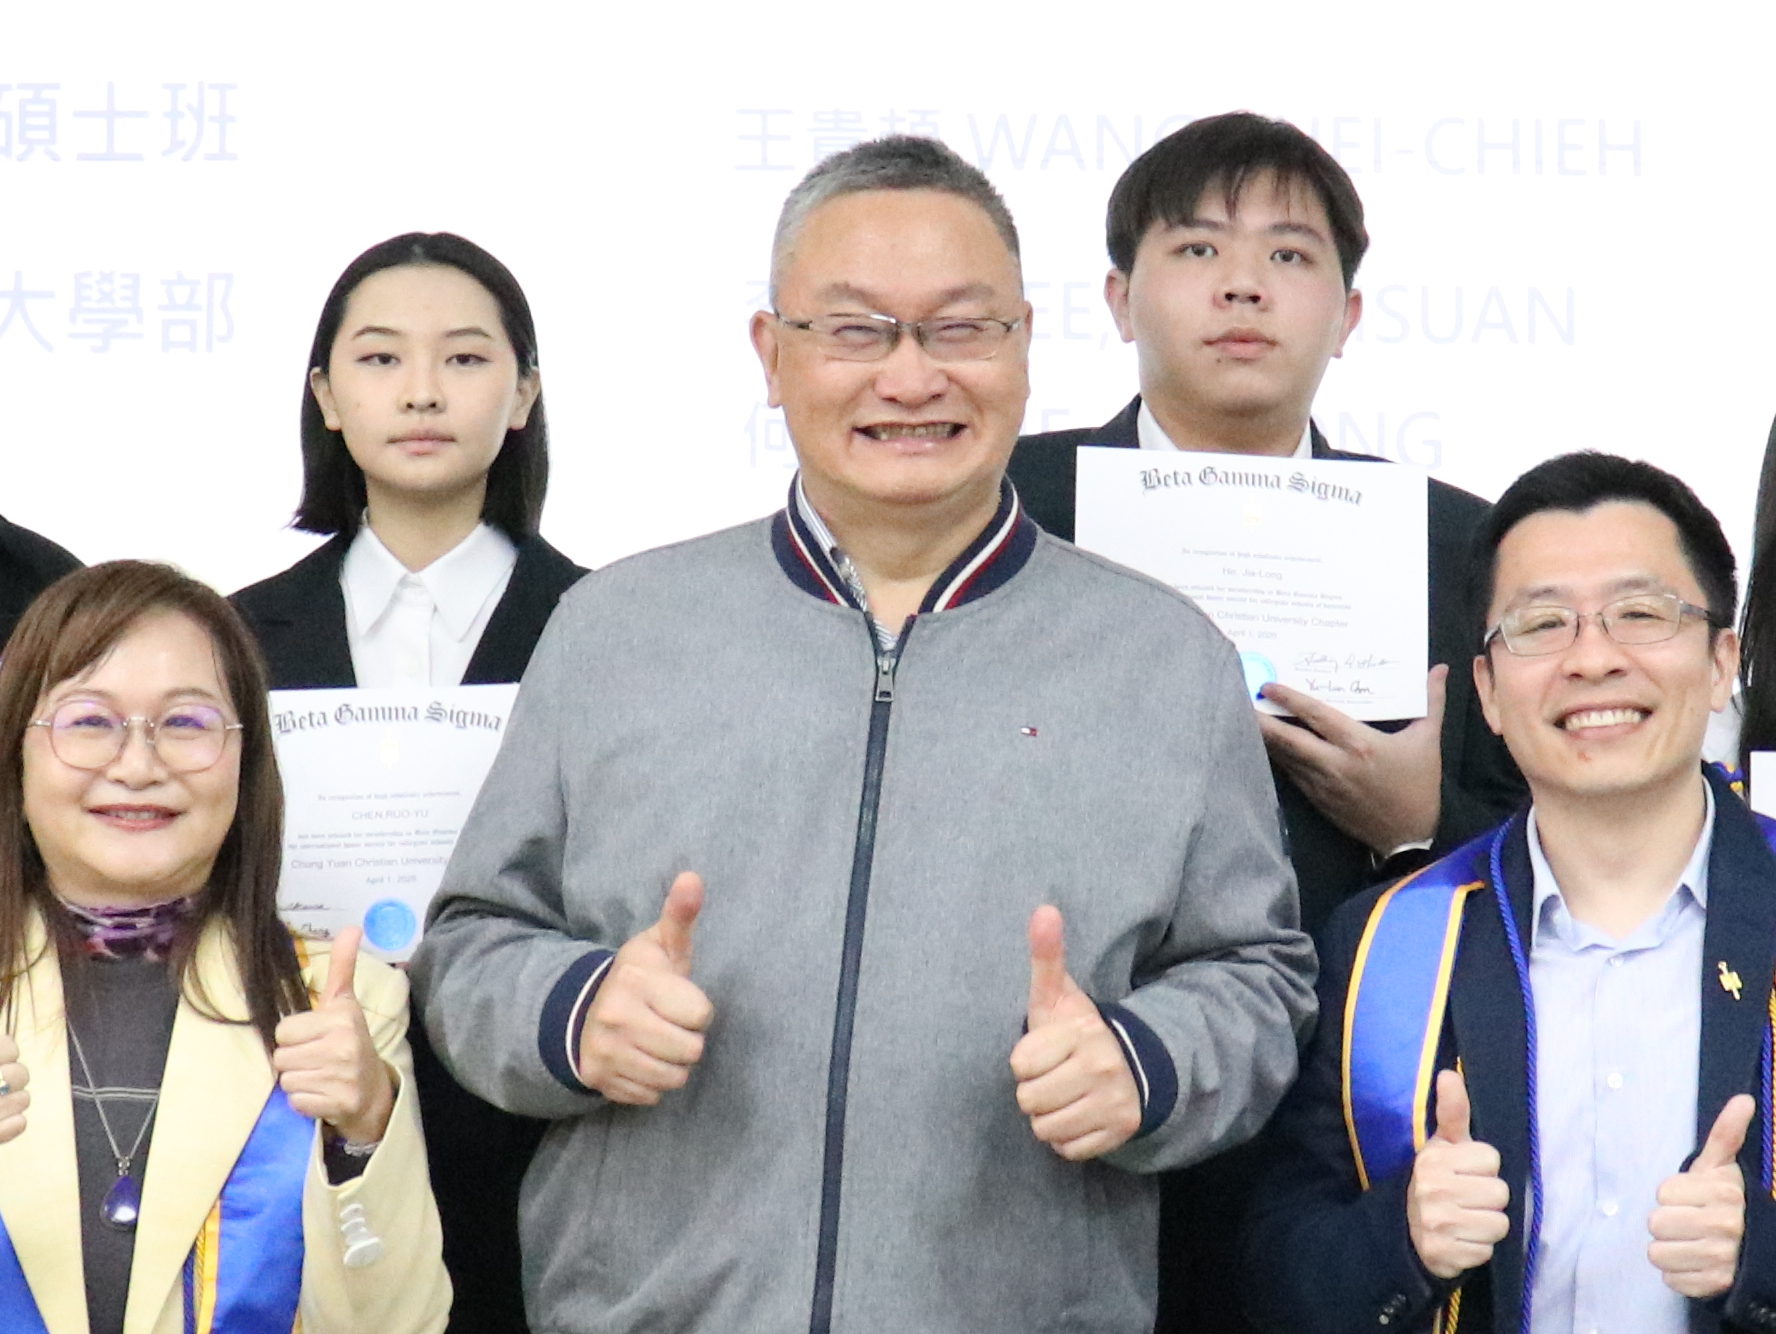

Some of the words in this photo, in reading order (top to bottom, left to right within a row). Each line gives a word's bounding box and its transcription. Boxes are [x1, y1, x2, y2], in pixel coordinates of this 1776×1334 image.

[1139, 467, 1193, 492] Beta
[1198, 466, 1281, 490] Gamma
[1286, 471, 1362, 506] Sigma
[272, 709, 328, 735] Beta
[333, 703, 419, 726] Gamma
[424, 700, 502, 732] Sigma
